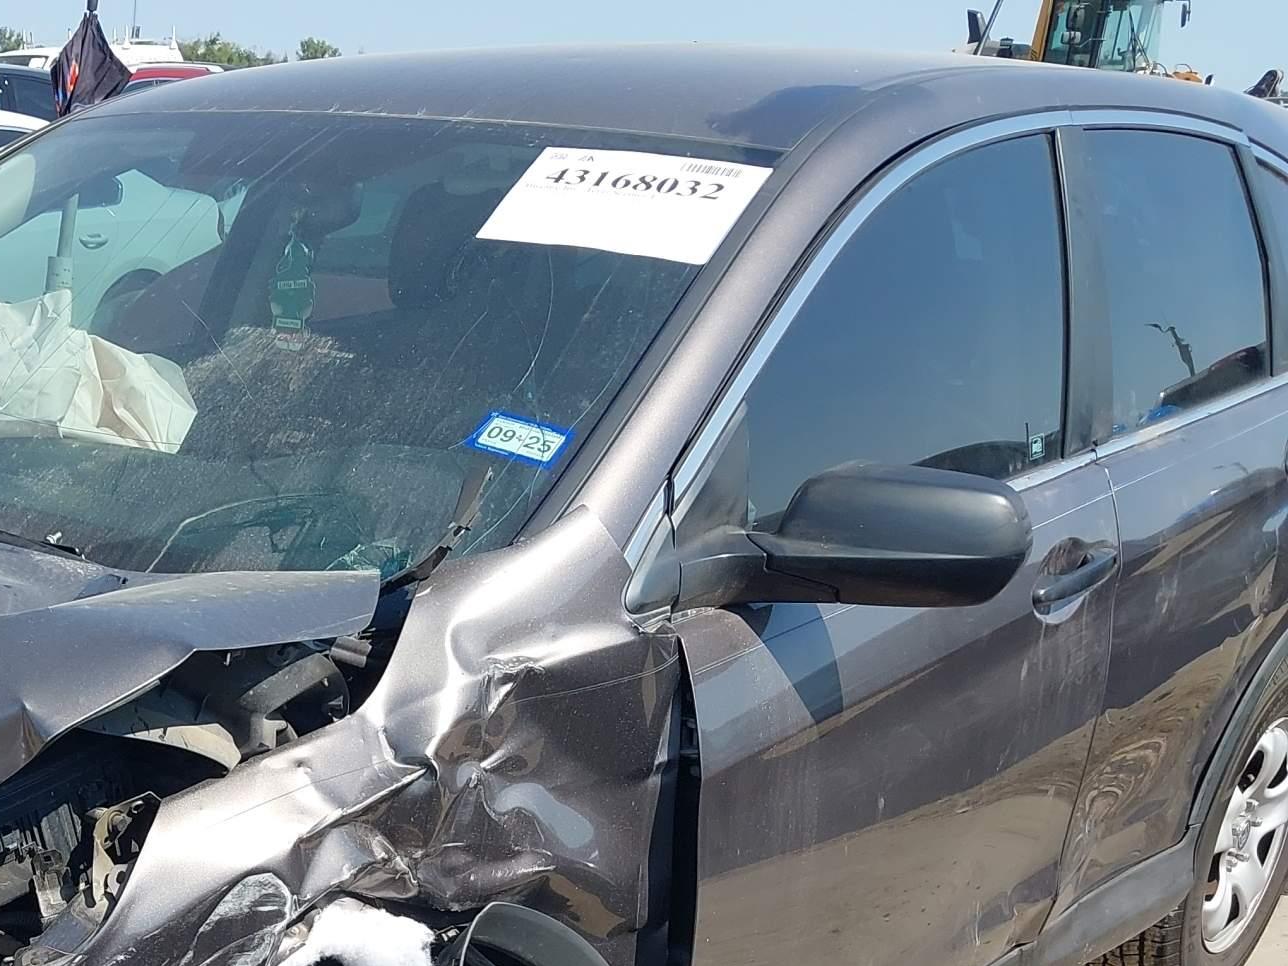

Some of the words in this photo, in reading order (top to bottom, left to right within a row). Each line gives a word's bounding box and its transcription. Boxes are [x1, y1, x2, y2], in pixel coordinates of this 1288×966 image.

[545, 167, 725, 200] 43168032
[486, 426, 516, 443] 09
[523, 435, 555, 454] 25
